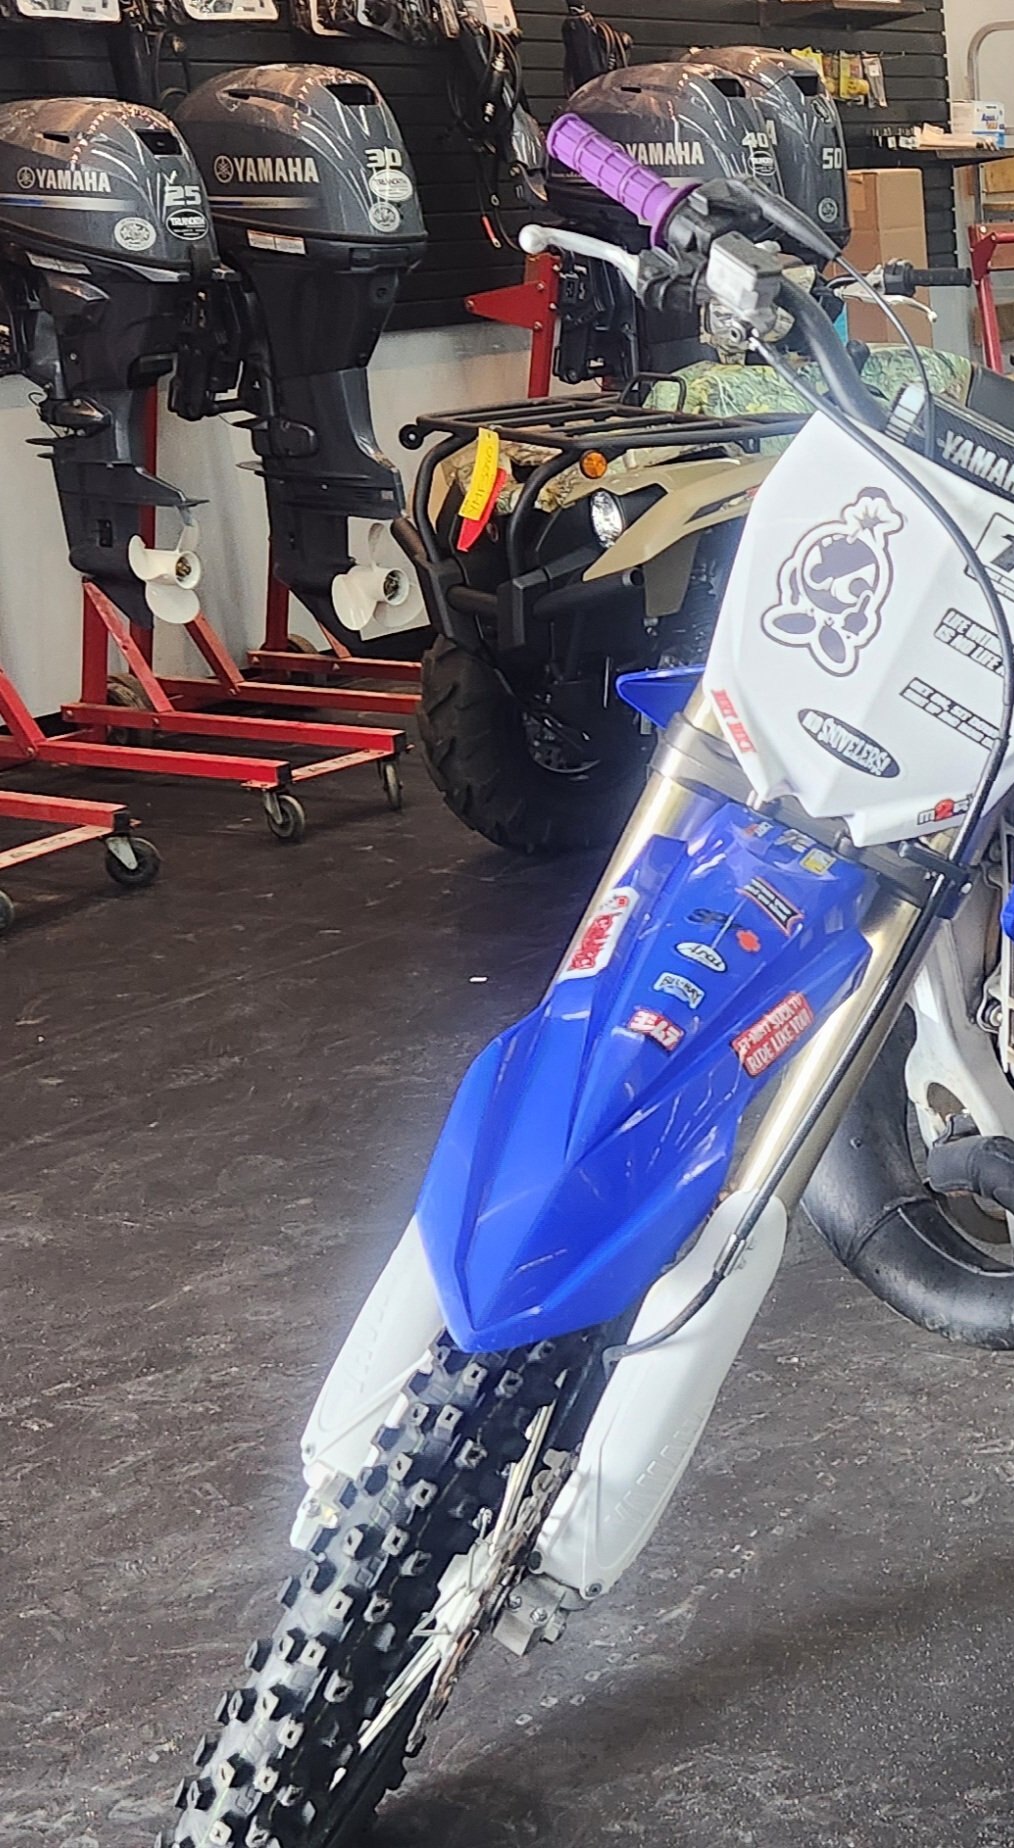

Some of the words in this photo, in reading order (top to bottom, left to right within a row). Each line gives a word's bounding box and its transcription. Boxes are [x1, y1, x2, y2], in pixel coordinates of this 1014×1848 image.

[742, 131, 769, 148] 40
[365, 149, 402, 168] 30
[627, 141, 704, 165] YAMAHA
[822, 147, 843, 169] 50
[36, 169, 111, 193] YAMAHA
[234, 157, 320, 183] YAMAHA
[164, 185, 201, 206] 25
[746, 1041, 775, 1072] RIDE
[769, 1023, 795, 1052] LIKE
